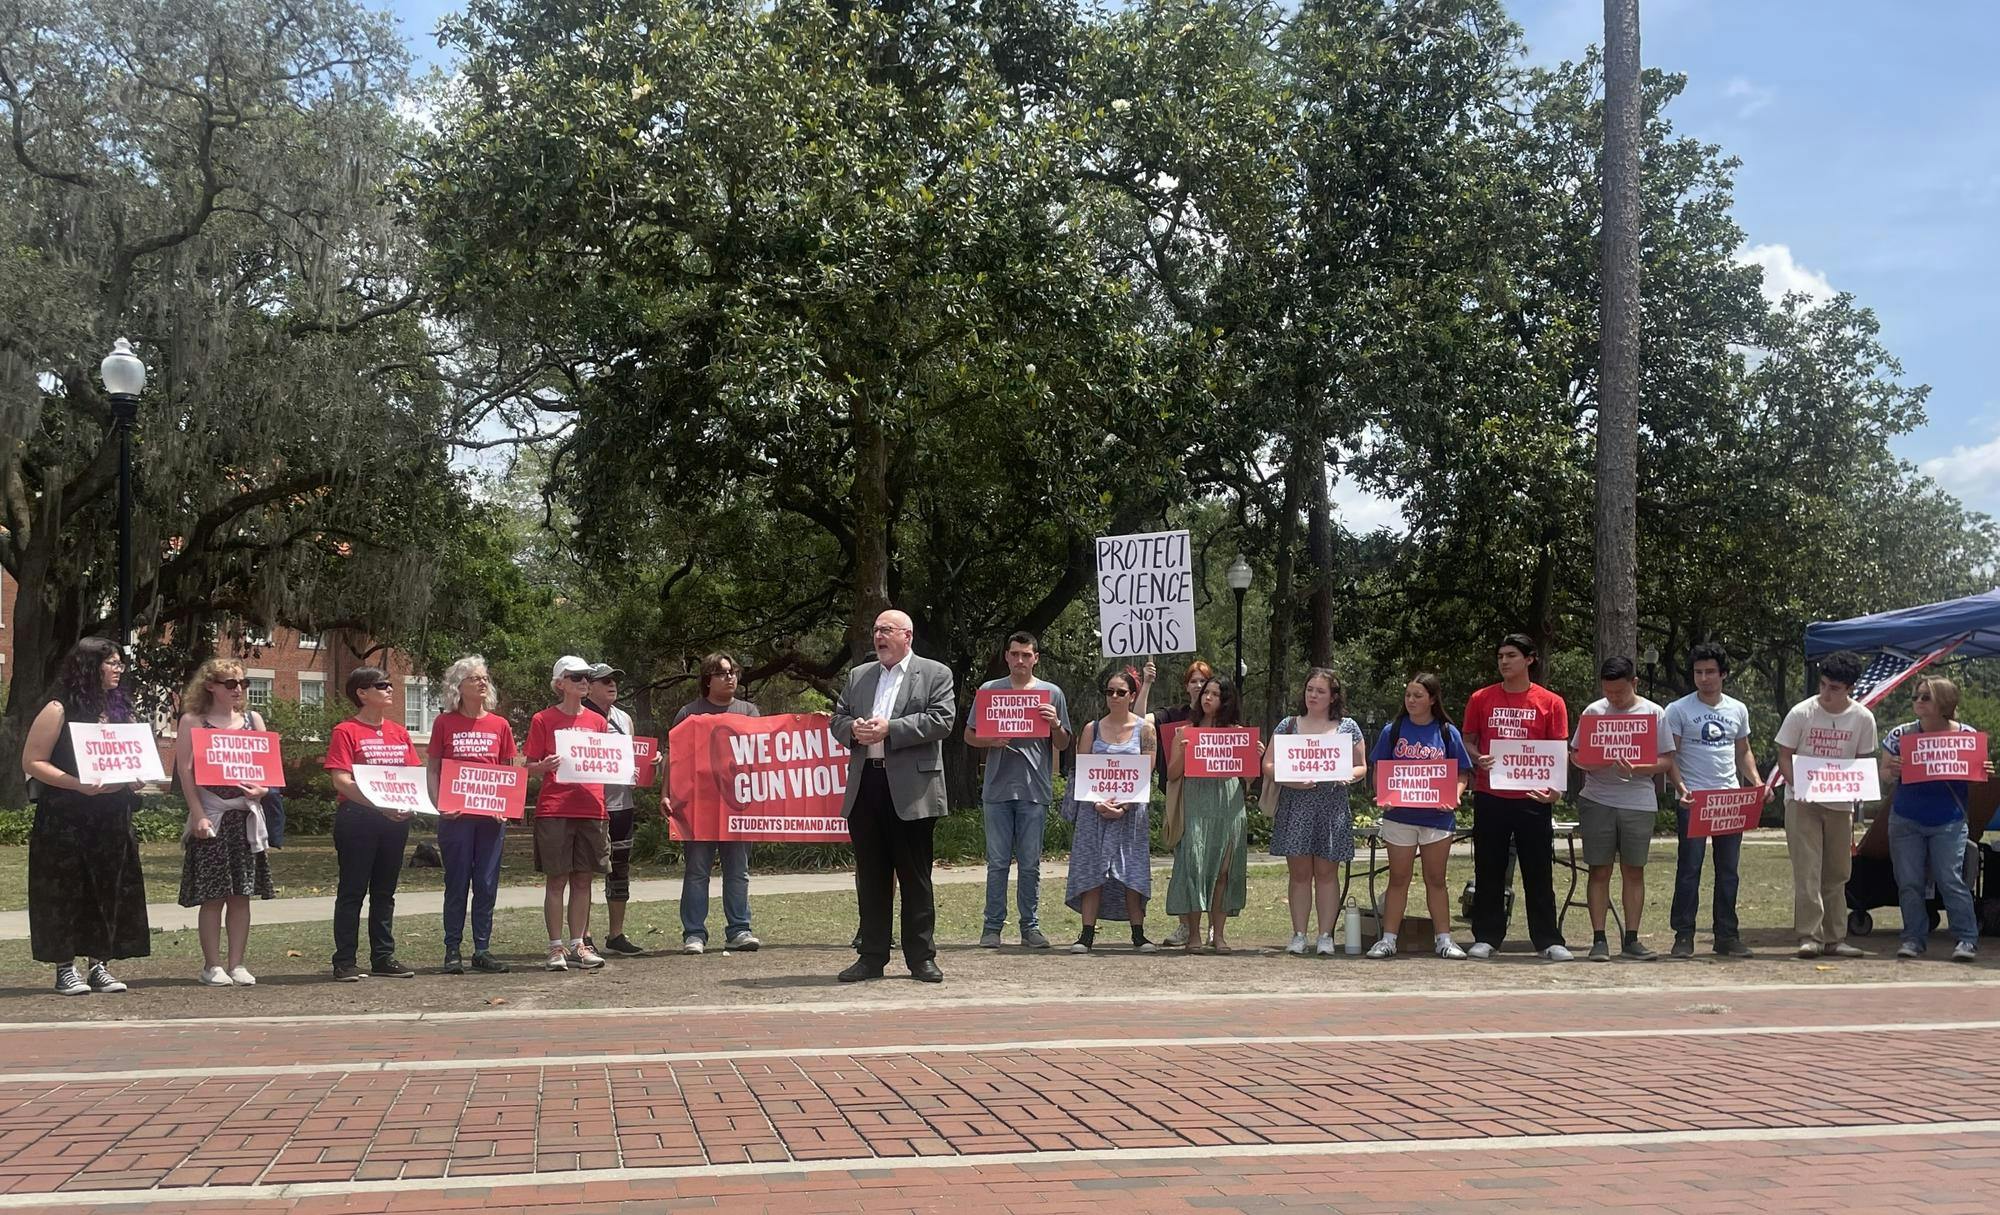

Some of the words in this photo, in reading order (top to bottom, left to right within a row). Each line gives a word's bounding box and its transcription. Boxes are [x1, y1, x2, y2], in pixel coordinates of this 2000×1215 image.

[1098, 534, 1189, 571] PROTECT
[1101, 571, 1191, 606] SCIENCE
[1108, 619, 1180, 655] GUNS
[992, 696, 1039, 707] STUDENTS
[988, 709, 1024, 719] DEMAND
[1494, 708, 1535, 719] STUDENTS
[1000, 721, 1032, 731] ACTION
[1489, 718, 1520, 727] DEMAND
[1598, 721, 1647, 733] STUDENTS
[101, 729, 116, 740] Text
[1499, 728, 1527, 737] ACTION
[213, 736, 268, 751] STUDENTS
[588, 737, 602, 745] Text
[1200, 734, 1248, 745] STUDENTS
[1306, 739, 1320, 747] Text
[1592, 734, 1631, 746] DEMAND
[1918, 738, 1974, 750] STUDENTS
[85, 741, 142, 755] STUDENTS
[729, 733, 772, 765] WE
[775, 729, 823, 762] CAN
[827, 728, 851, 757] E
[1196, 747, 1232, 758] DEMAND
[1605, 747, 1639, 758] ACTION
[208, 750, 251, 764] DEMAND
[571, 746, 623, 760] STUDENTS
[1288, 748, 1340, 760] STUDENTS
[1913, 750, 1956, 763] DEMAND
[98, 756, 142, 771] 644-33
[582, 760, 619, 773] 644-33
[1106, 759, 1120, 767] Text
[1208, 760, 1241, 770] ACTION
[1299, 760, 1336, 772] 644-33
[1502, 755, 1555, 767] STUDENTS
[225, 766, 263, 778] ACTION
[1394, 766, 1446, 777] STUDENTS
[1513, 768, 1550, 780] 644-33
[1928, 763, 1967, 773] ACTION
[461, 769, 515, 784] STUDENTS
[1088, 769, 1139, 780] STUDENTS
[1807, 770, 1864, 781] STUDENTS
[370, 781, 418, 795] STUDENTS
[453, 781, 496, 796] DEMAND
[734, 769, 786, 804] GUN
[788, 763, 849, 798] VIOL
[1098, 781, 1134, 793] 644-33
[1389, 778, 1429, 789] DEMAND
[1819, 783, 1860, 793] 644-33
[1402, 791, 1438, 801] ACTION
[1707, 793, 1756, 807] STUDENTS
[466, 796, 505, 810] ACTION
[1702, 807, 1739, 819] DEMAND
[731, 818, 782, 830] STUDENTS
[784, 819, 824, 831] DEMAND
[825, 819, 847, 831] ACTI
[1713, 817, 1744, 830] ACTION
